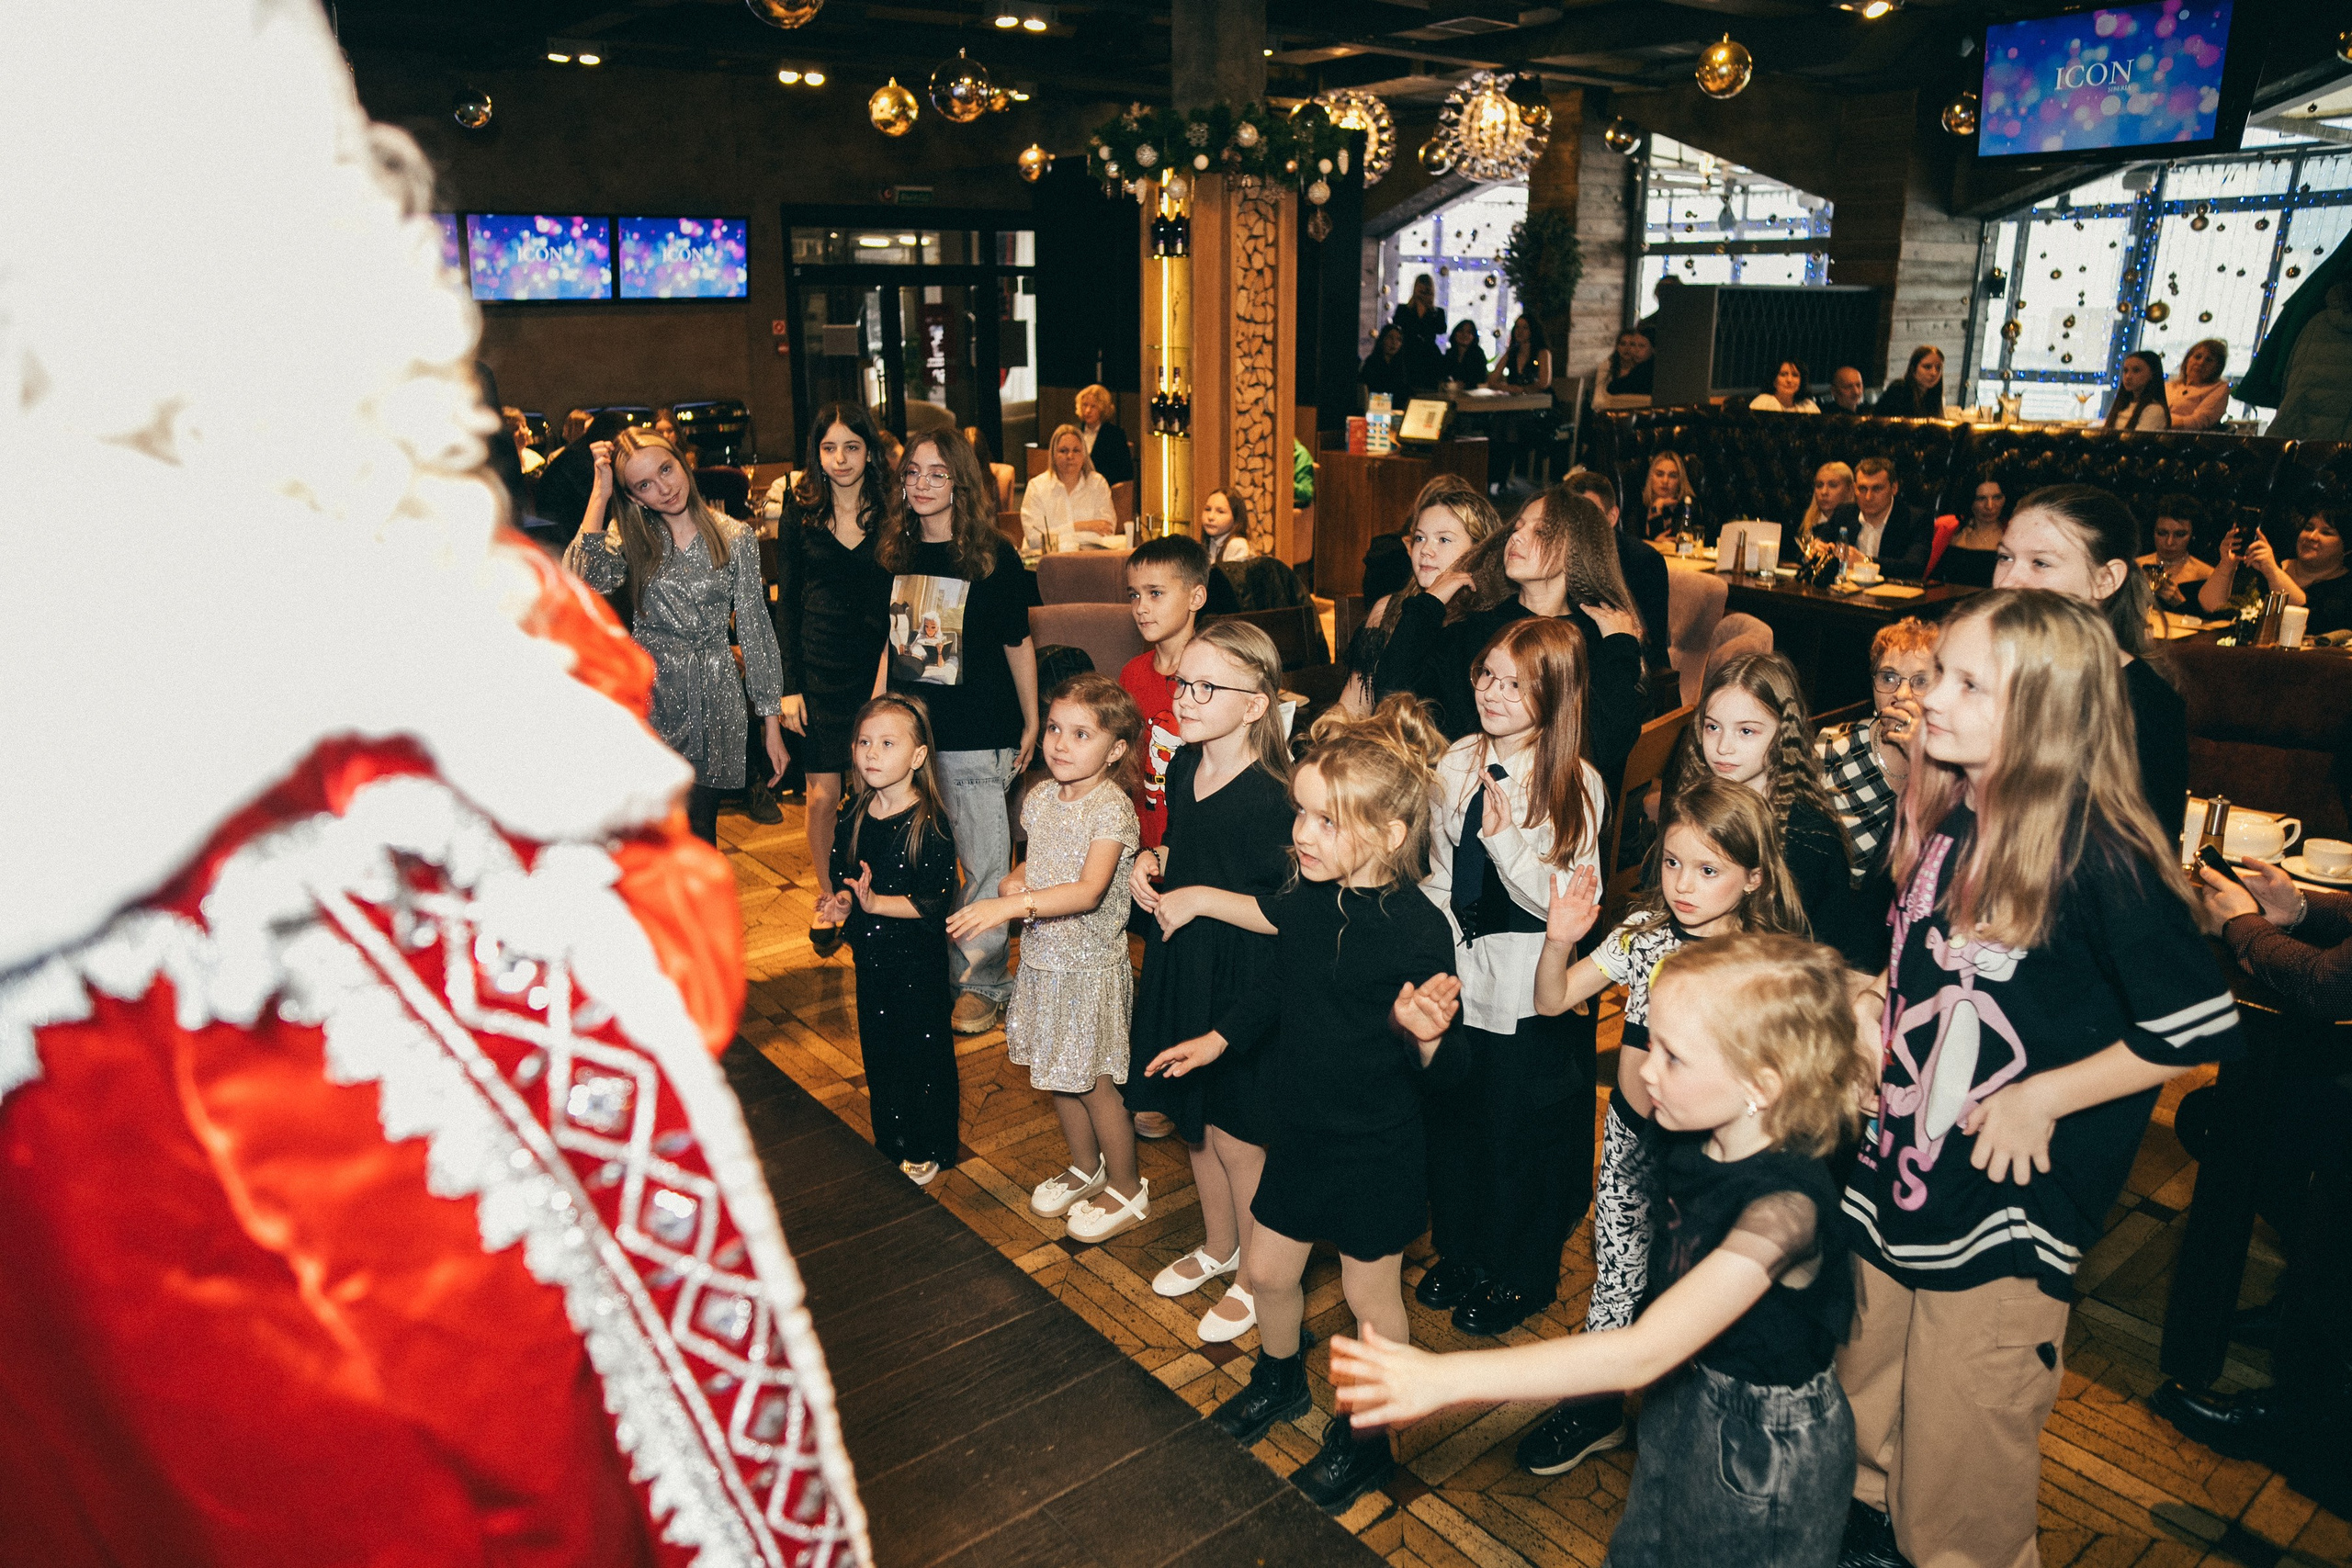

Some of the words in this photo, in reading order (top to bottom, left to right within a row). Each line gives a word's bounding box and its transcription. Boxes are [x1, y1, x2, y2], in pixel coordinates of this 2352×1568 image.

[2054, 59, 2134, 90] ICON
[517, 246, 562, 263] ICON
[662, 247, 704, 263] ICON
